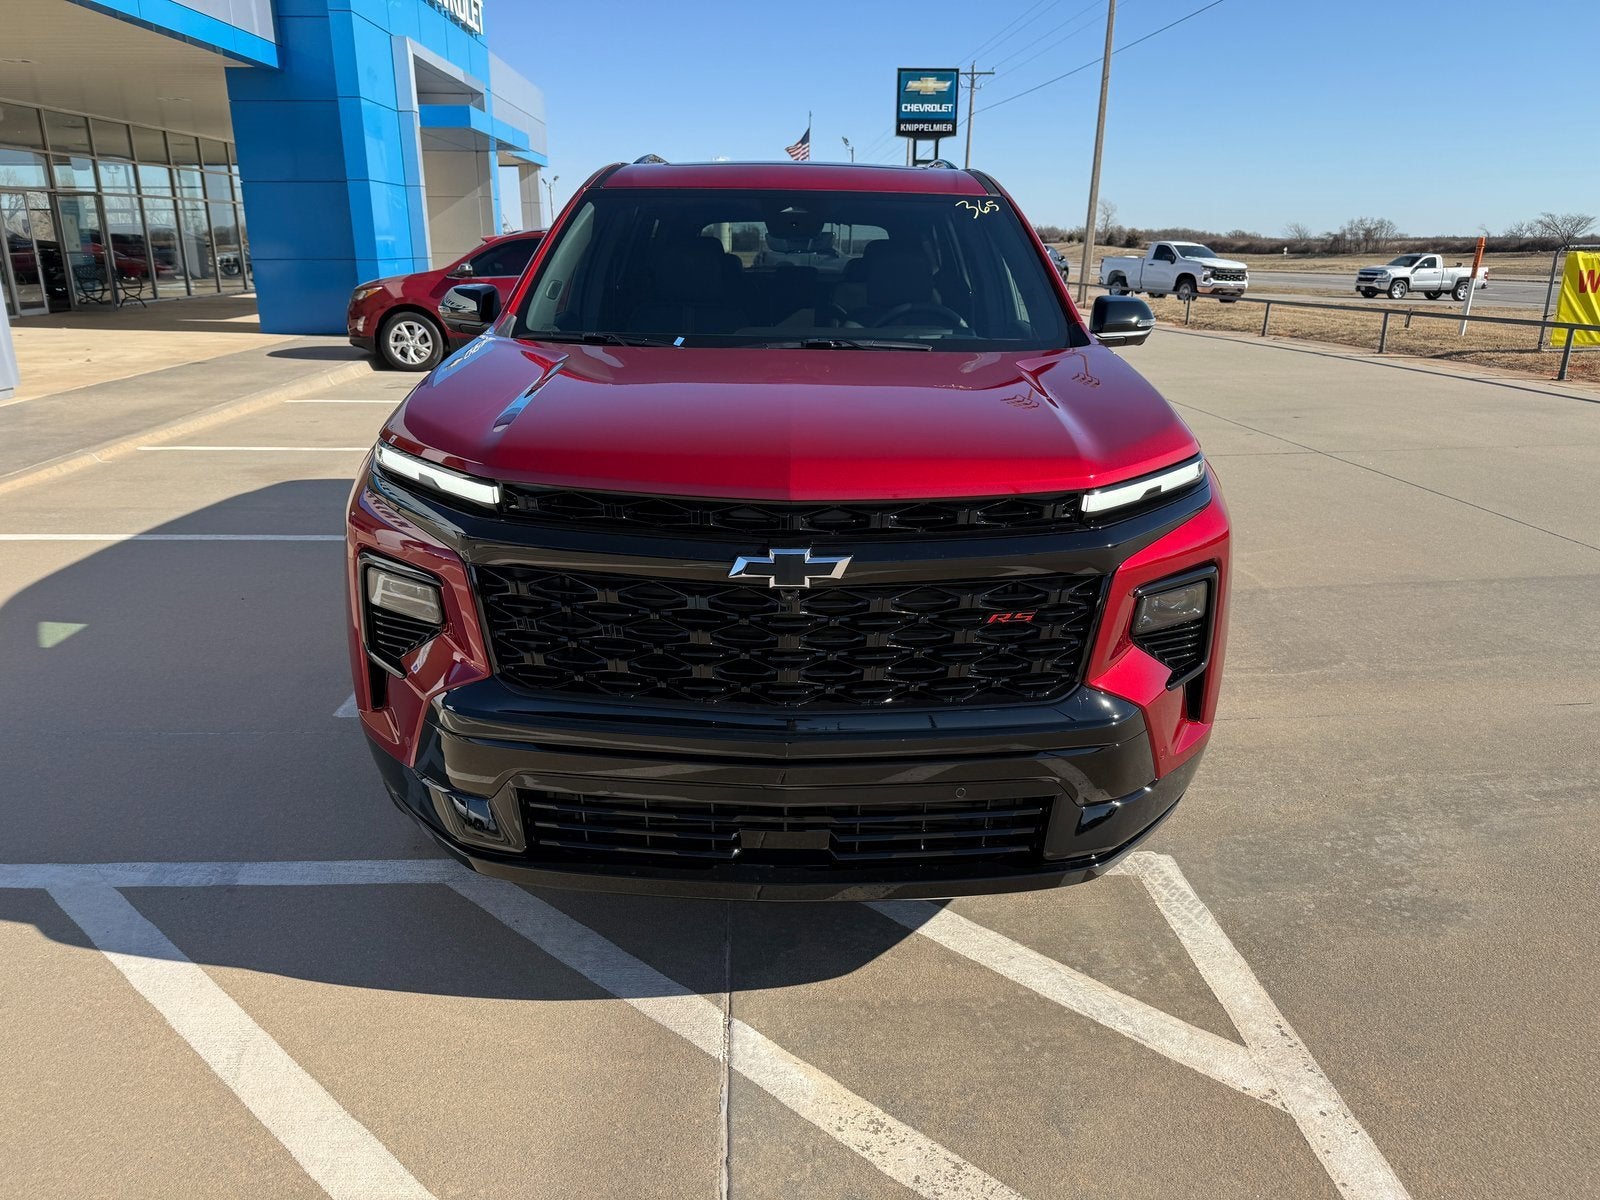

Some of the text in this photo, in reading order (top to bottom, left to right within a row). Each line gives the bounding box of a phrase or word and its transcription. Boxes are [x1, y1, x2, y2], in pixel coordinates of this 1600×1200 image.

[901, 103, 953, 113] CHEVROLET
[900, 123, 953, 132] KNIPPELMIER
[955, 199, 1000, 219] 365
[986, 611, 1036, 624] RS
